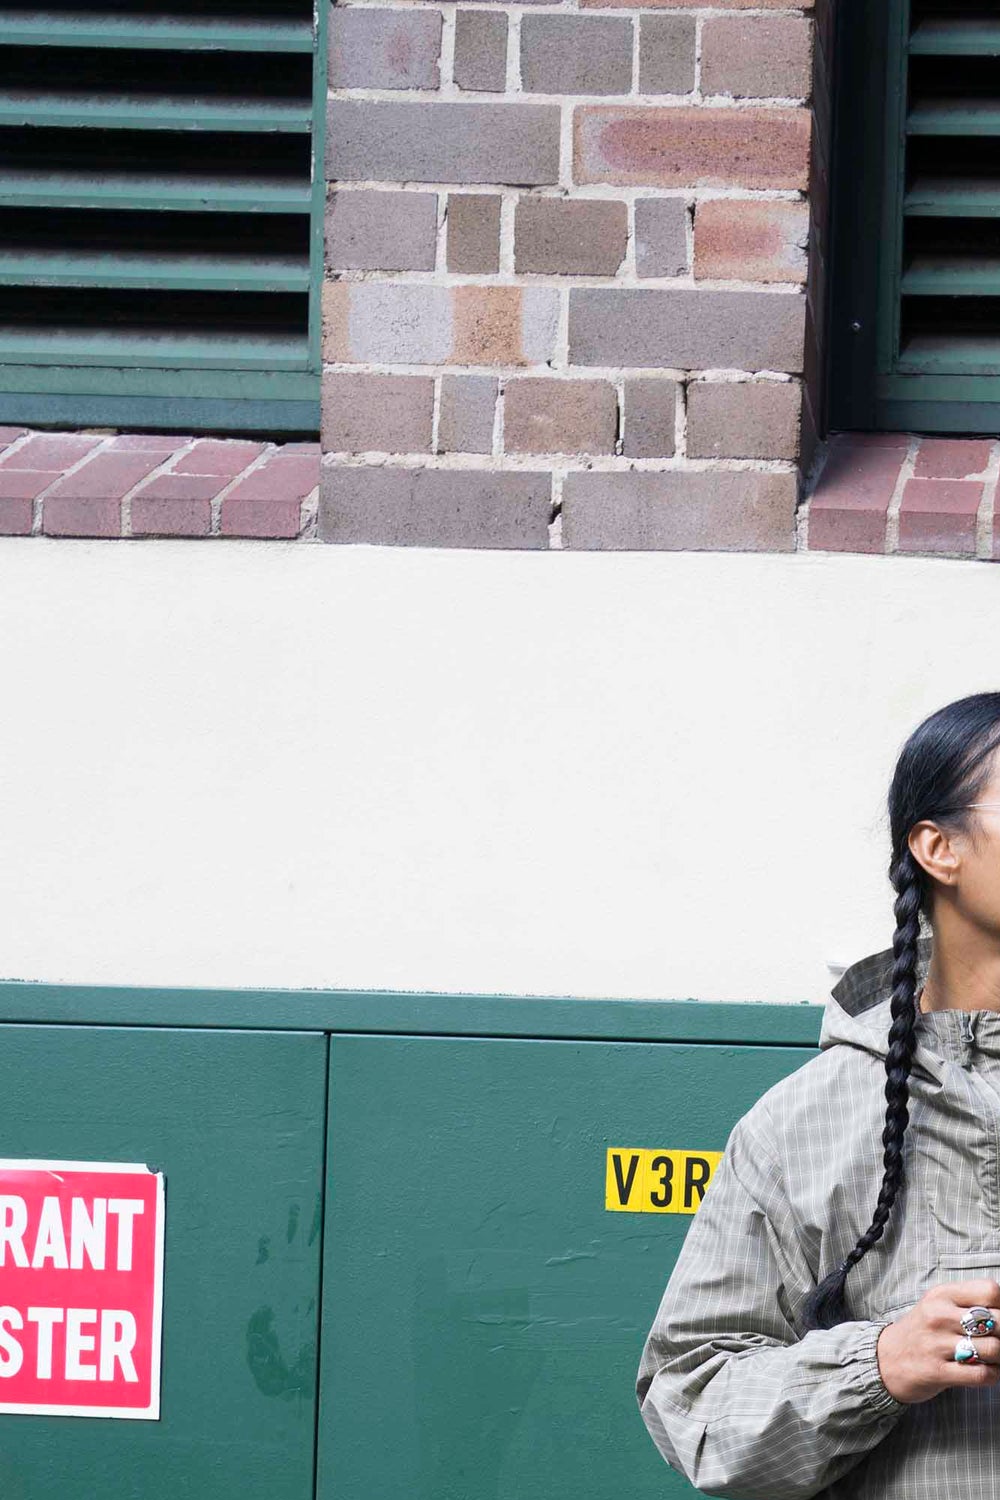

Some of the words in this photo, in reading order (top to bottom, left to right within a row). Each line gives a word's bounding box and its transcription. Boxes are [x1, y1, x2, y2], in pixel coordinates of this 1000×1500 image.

[612, 1154, 711, 1208] V3R
[0, 1194, 145, 1272] RANT
[0, 1305, 139, 1383] STER
